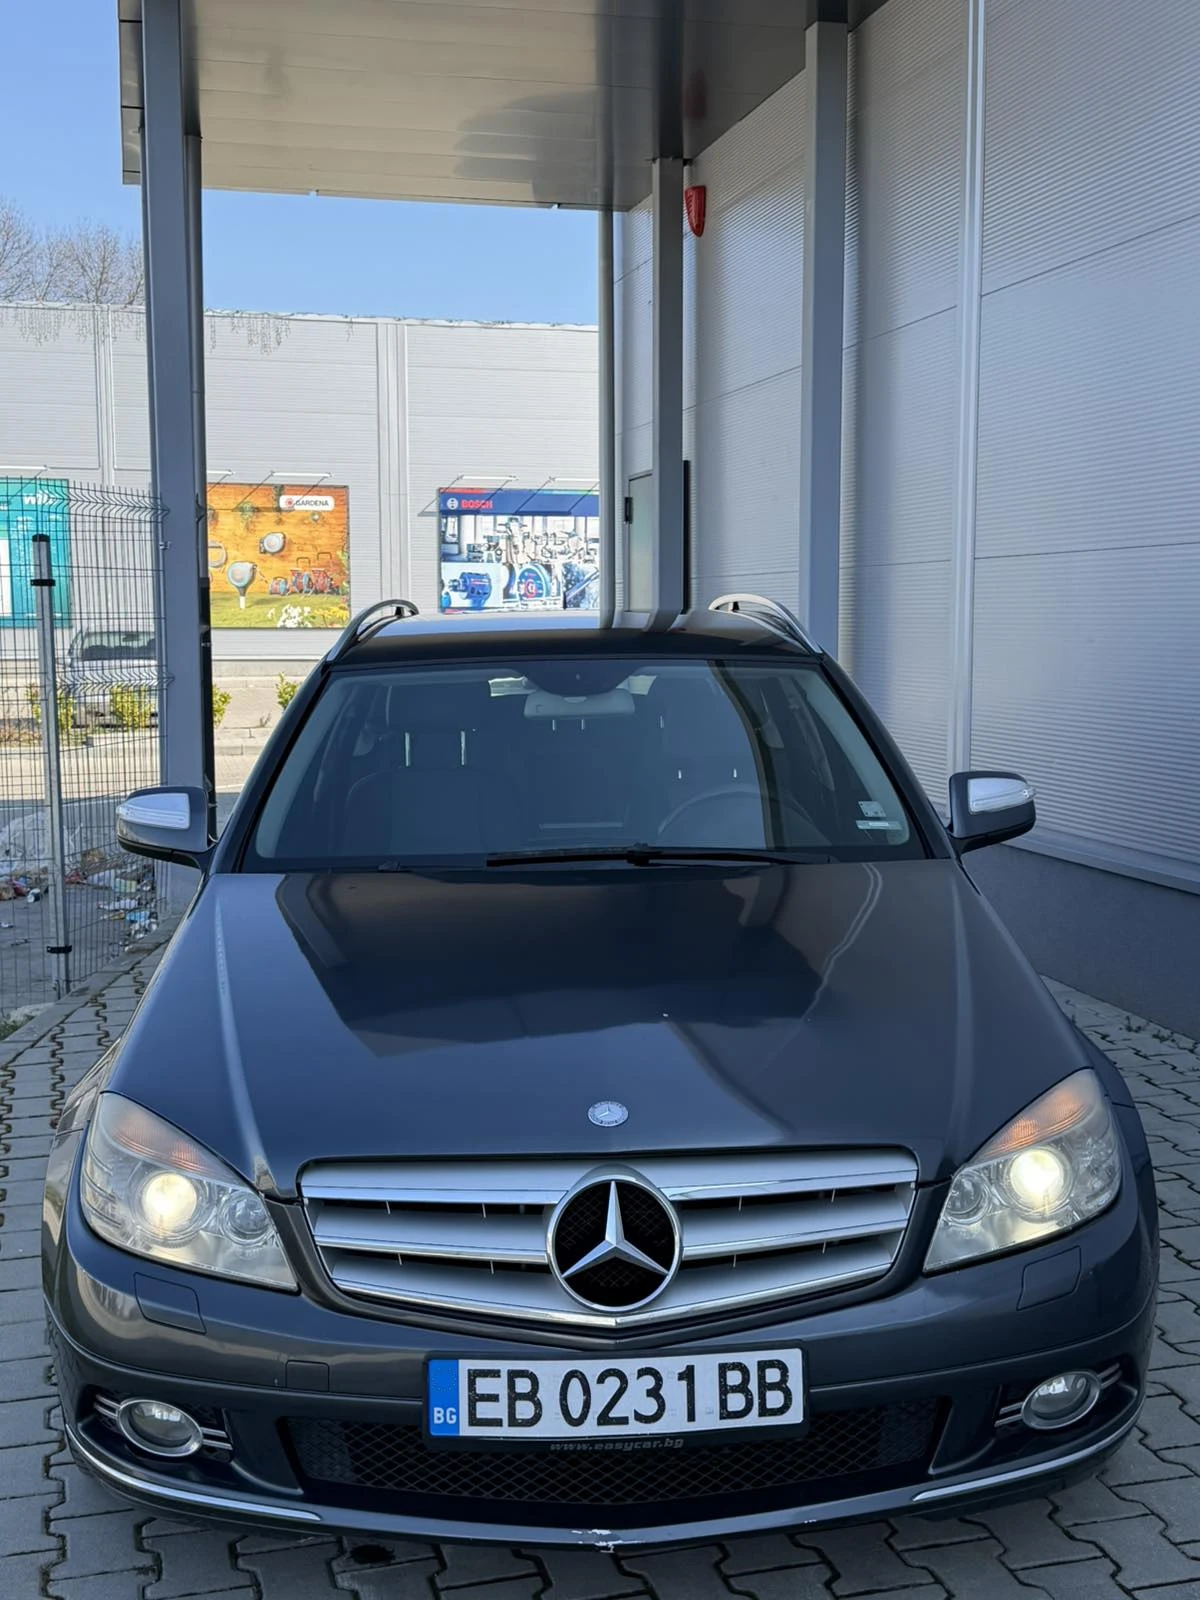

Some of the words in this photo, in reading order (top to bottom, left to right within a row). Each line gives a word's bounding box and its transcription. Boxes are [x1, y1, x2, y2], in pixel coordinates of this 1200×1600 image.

[461, 499, 494, 509] BOSCH
[467, 1368, 543, 1428] EB
[559, 1364, 696, 1427] 0231
[718, 1358, 793, 1421] BB
[433, 1407, 457, 1424] BG
[549, 1438, 685, 1451] www.easycar.bg
